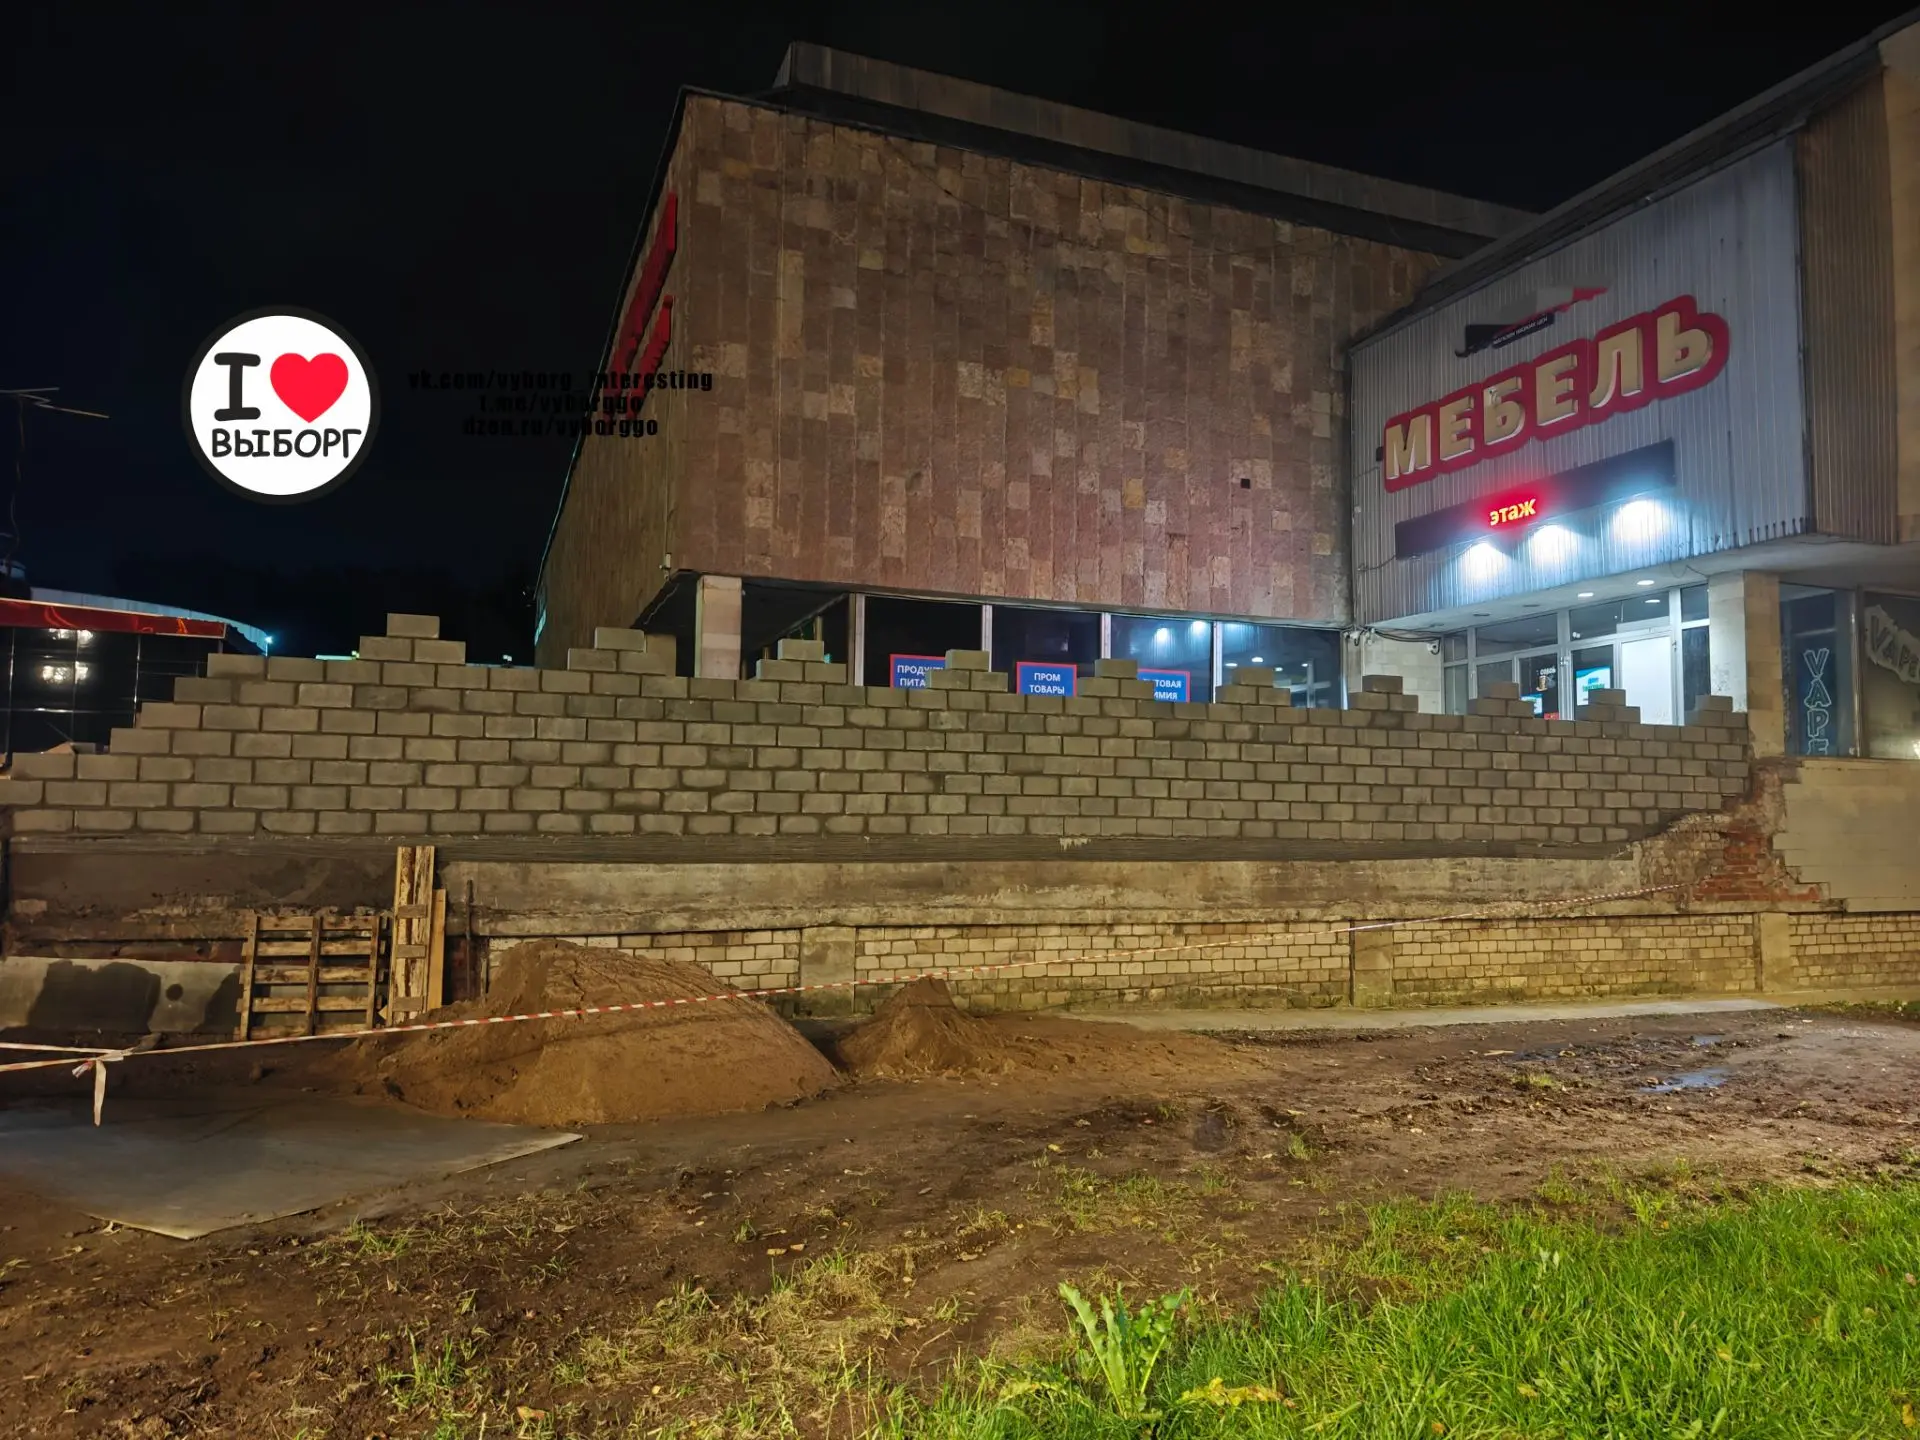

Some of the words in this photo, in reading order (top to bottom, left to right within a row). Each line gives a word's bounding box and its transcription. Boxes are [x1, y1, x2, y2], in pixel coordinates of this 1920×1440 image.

[1385, 311, 1714, 479] МЕБЕЛЬ
[1489, 496, 1537, 526] этаж
[1034, 672, 1061, 682] ПРОМ
[899, 678, 926, 688] ПИТА
[1144, 679, 1182, 689] ТОВАЯ
[1029, 684, 1065, 695] ТОВАРЫ
[1153, 690, 1178, 701] ИМИЯ
[1803, 647, 1832, 755] VAPE
